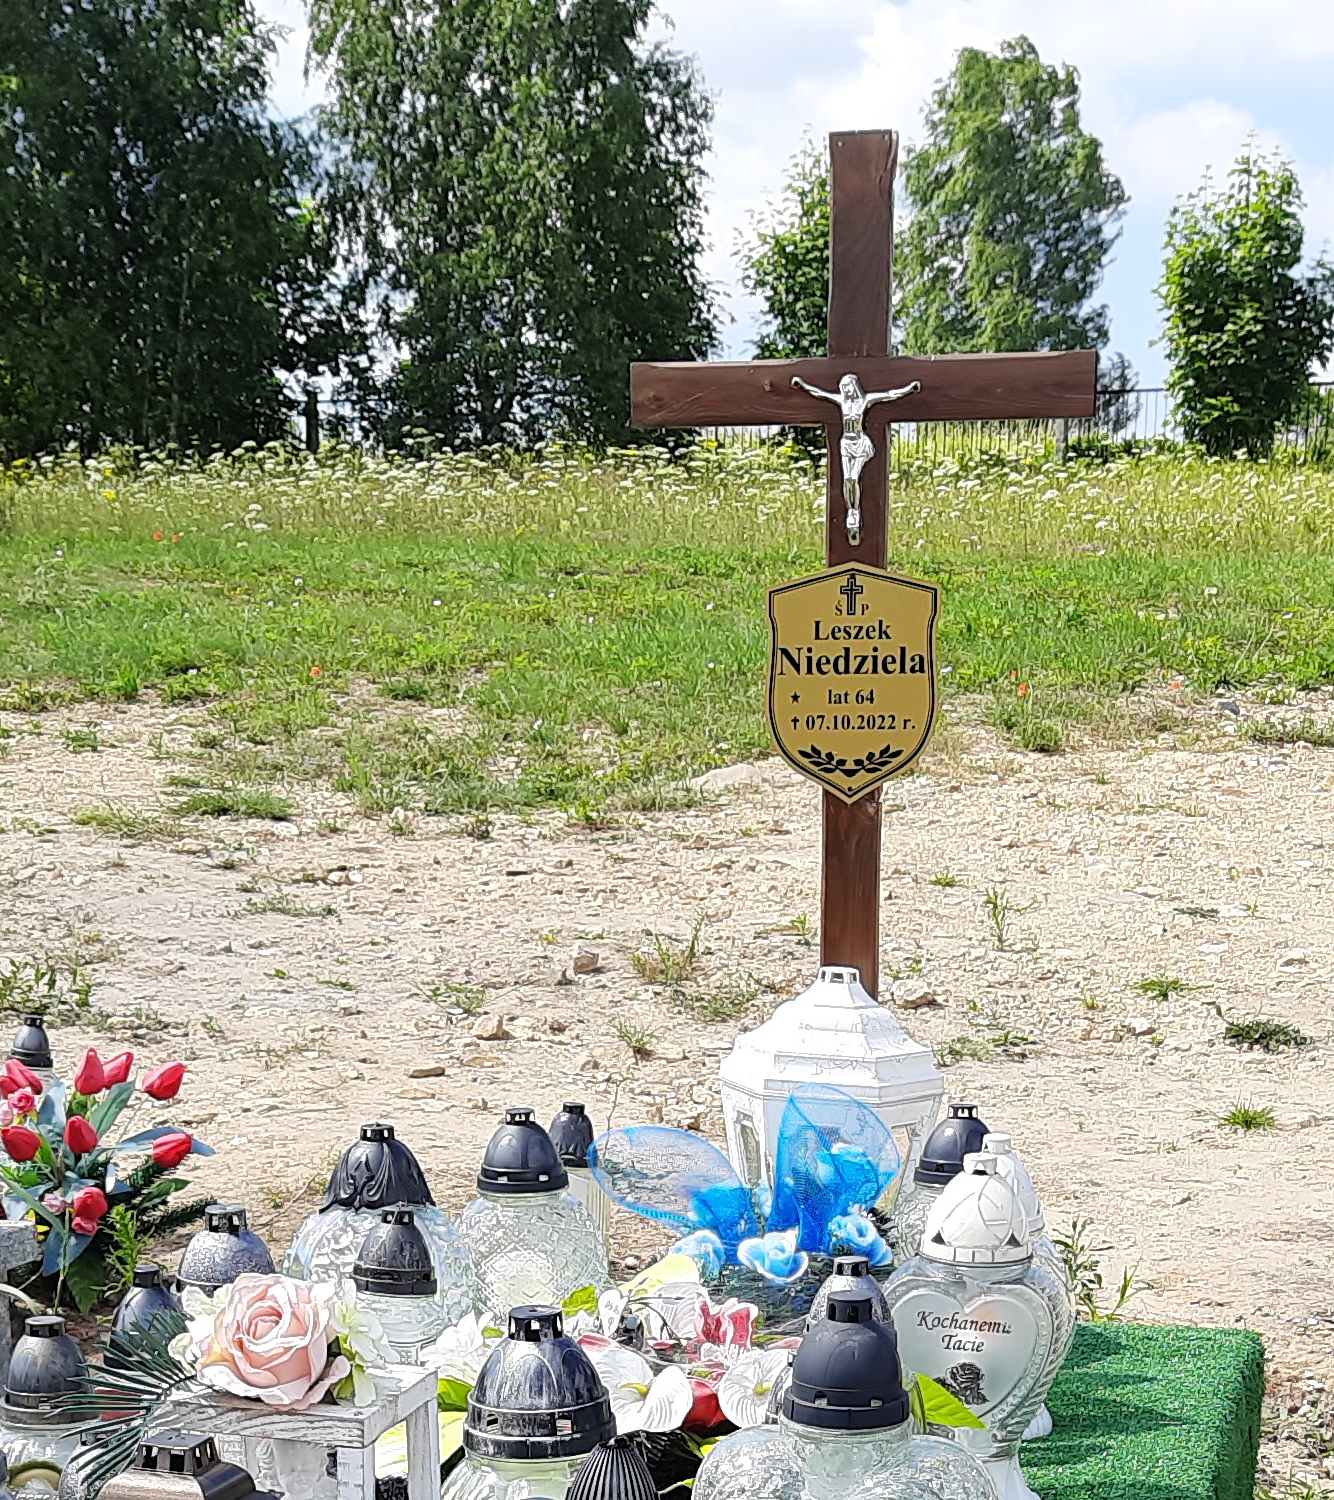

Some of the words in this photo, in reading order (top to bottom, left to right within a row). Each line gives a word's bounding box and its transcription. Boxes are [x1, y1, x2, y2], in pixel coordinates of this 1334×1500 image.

[813, 620, 892, 641] Leszek
[777, 646, 926, 676] Niedziela
[827, 689, 850, 705] lat
[855, 689, 875, 705] 64
[805, 714, 896, 731] 07.10.2022
[902, 717, 916, 730] r.
[917, 1310, 1012, 1335] Kochanemu
[941, 1334, 985, 1352] Tacie
